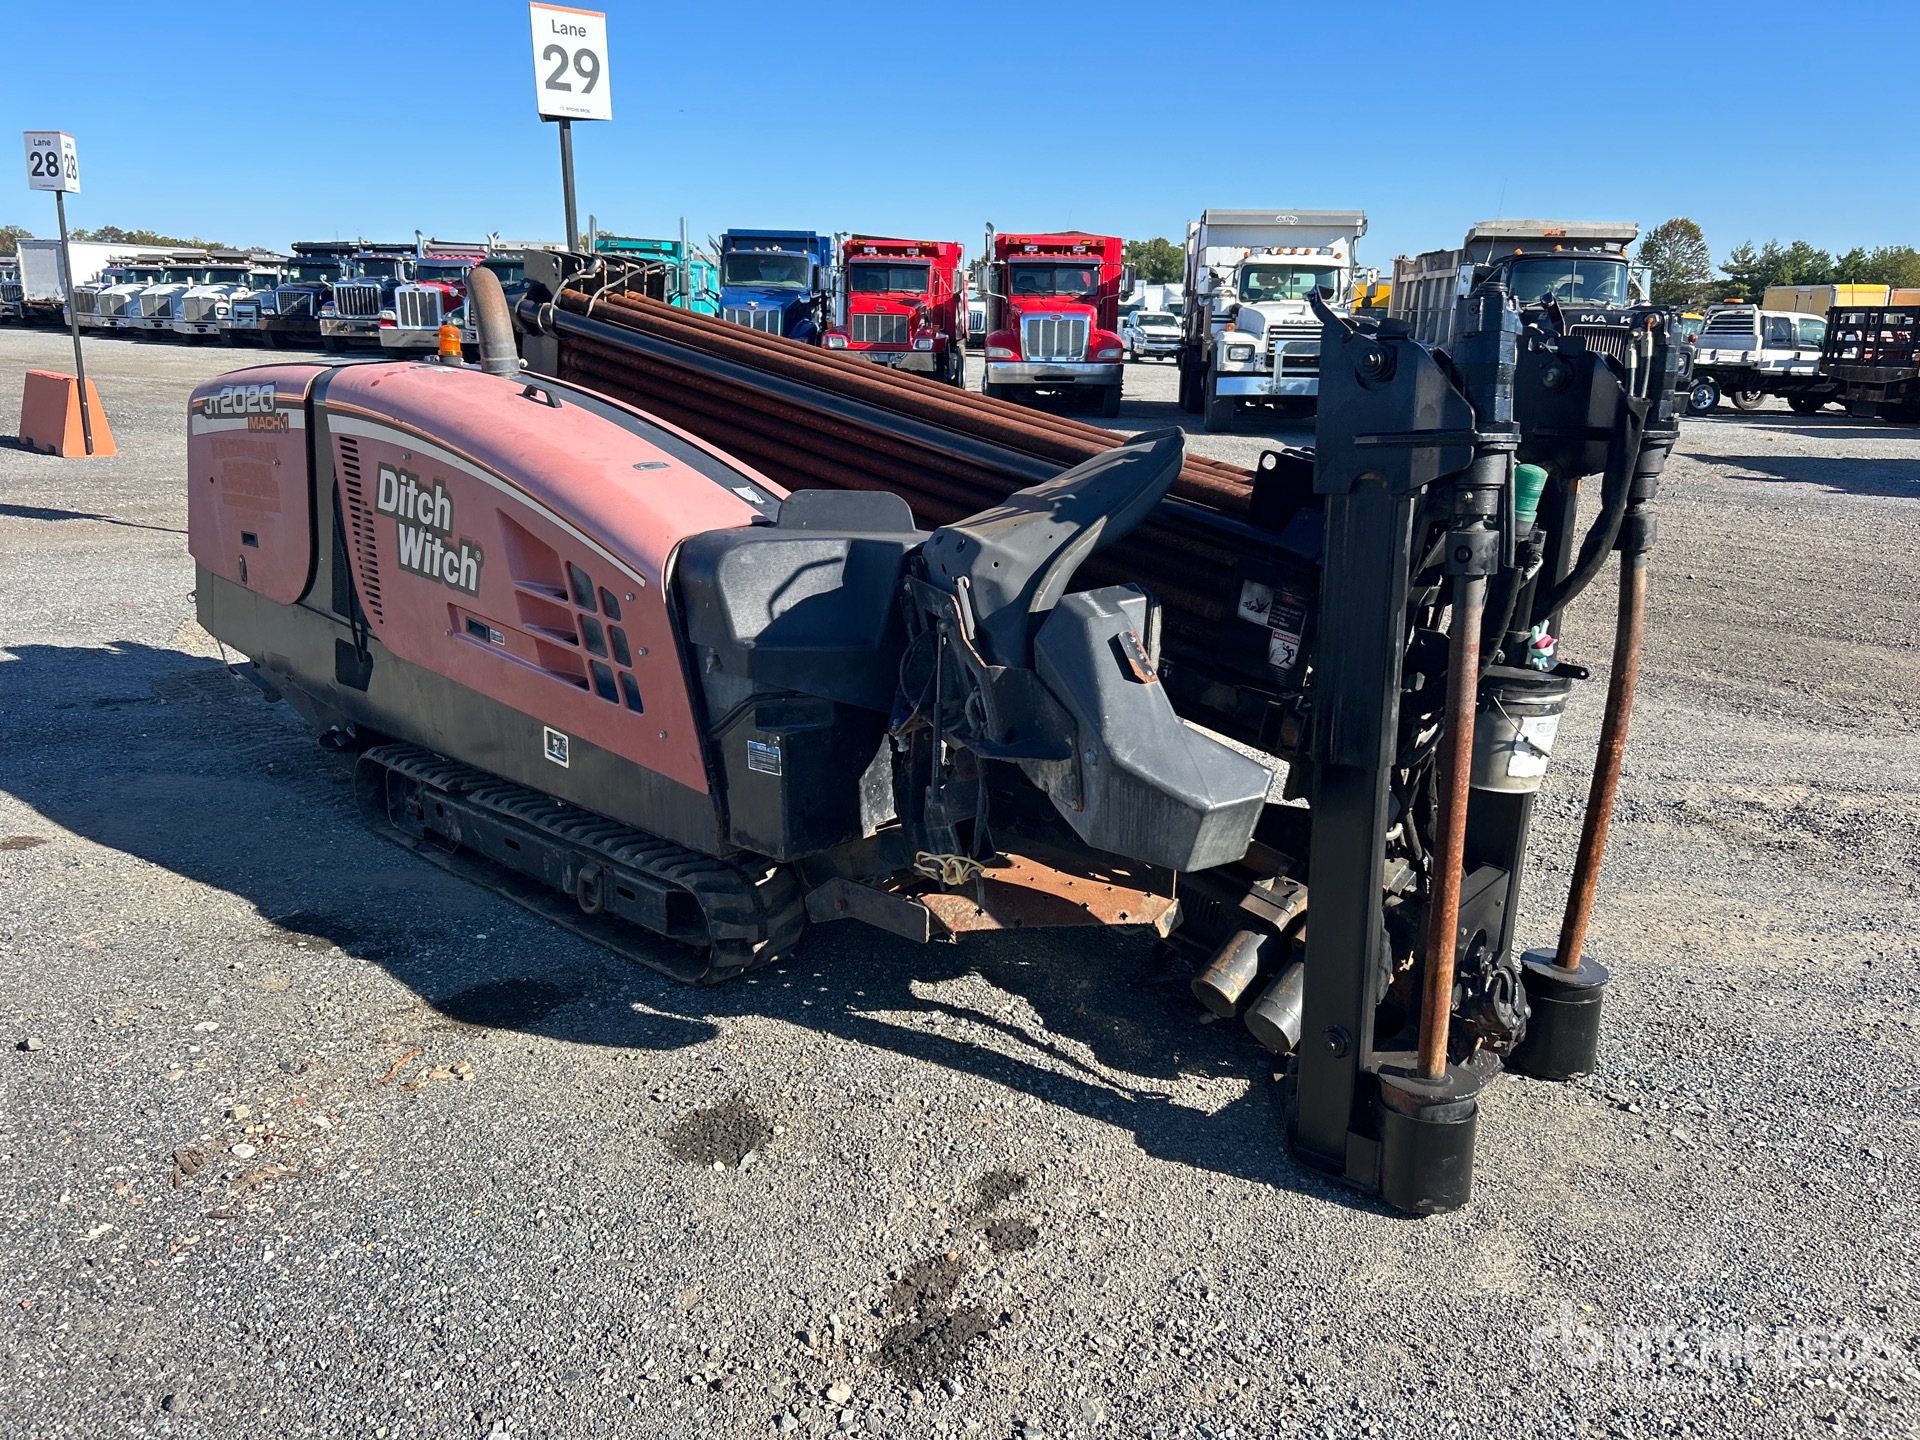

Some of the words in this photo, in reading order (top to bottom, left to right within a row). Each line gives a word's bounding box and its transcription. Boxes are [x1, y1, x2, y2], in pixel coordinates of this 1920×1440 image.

[551, 19, 587, 37] Lane
[542, 44, 600, 94] 29
[33, 138, 52, 147] Lane
[29, 151, 59, 177] 28
[64, 153, 77, 180] 28
[249, 415, 280, 430] MACH
[377, 467, 451, 531] Ditch
